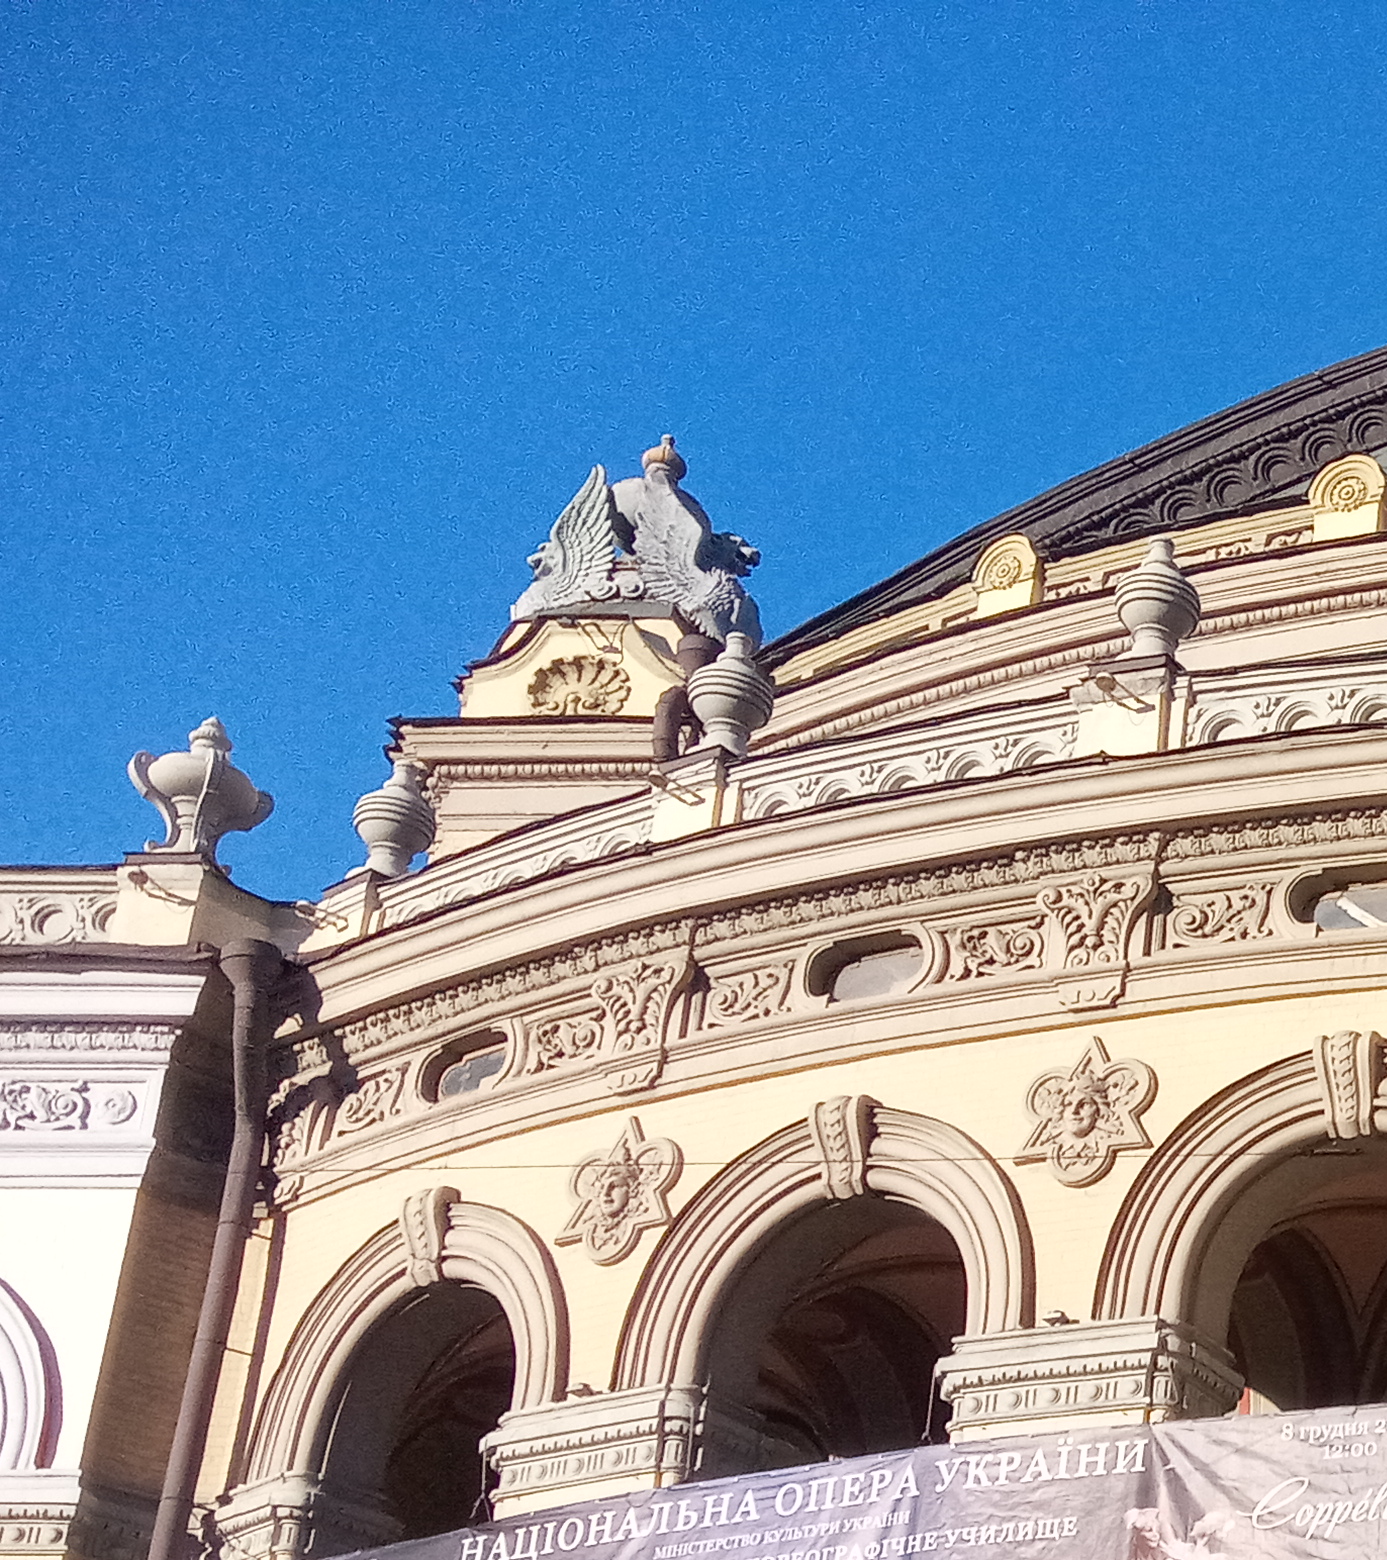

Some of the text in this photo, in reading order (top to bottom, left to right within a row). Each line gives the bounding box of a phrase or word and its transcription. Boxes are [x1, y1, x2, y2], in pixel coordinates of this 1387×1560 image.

[1280, 1422, 1294, 1441] 8
[1299, 1420, 1369, 1443] грудня
[1322, 1441, 1378, 1460] 12:00
[775, 1463, 920, 1517] ОПЕРА
[934, 1437, 1149, 1494] УКРАЇНИ
[653, 1510, 910, 1560] МІНІСТЕРСТВО КУЛЬТУРИ УКРАЇНИ
[948, 1516, 1078, 1548] УЧИЛИЩЕ
